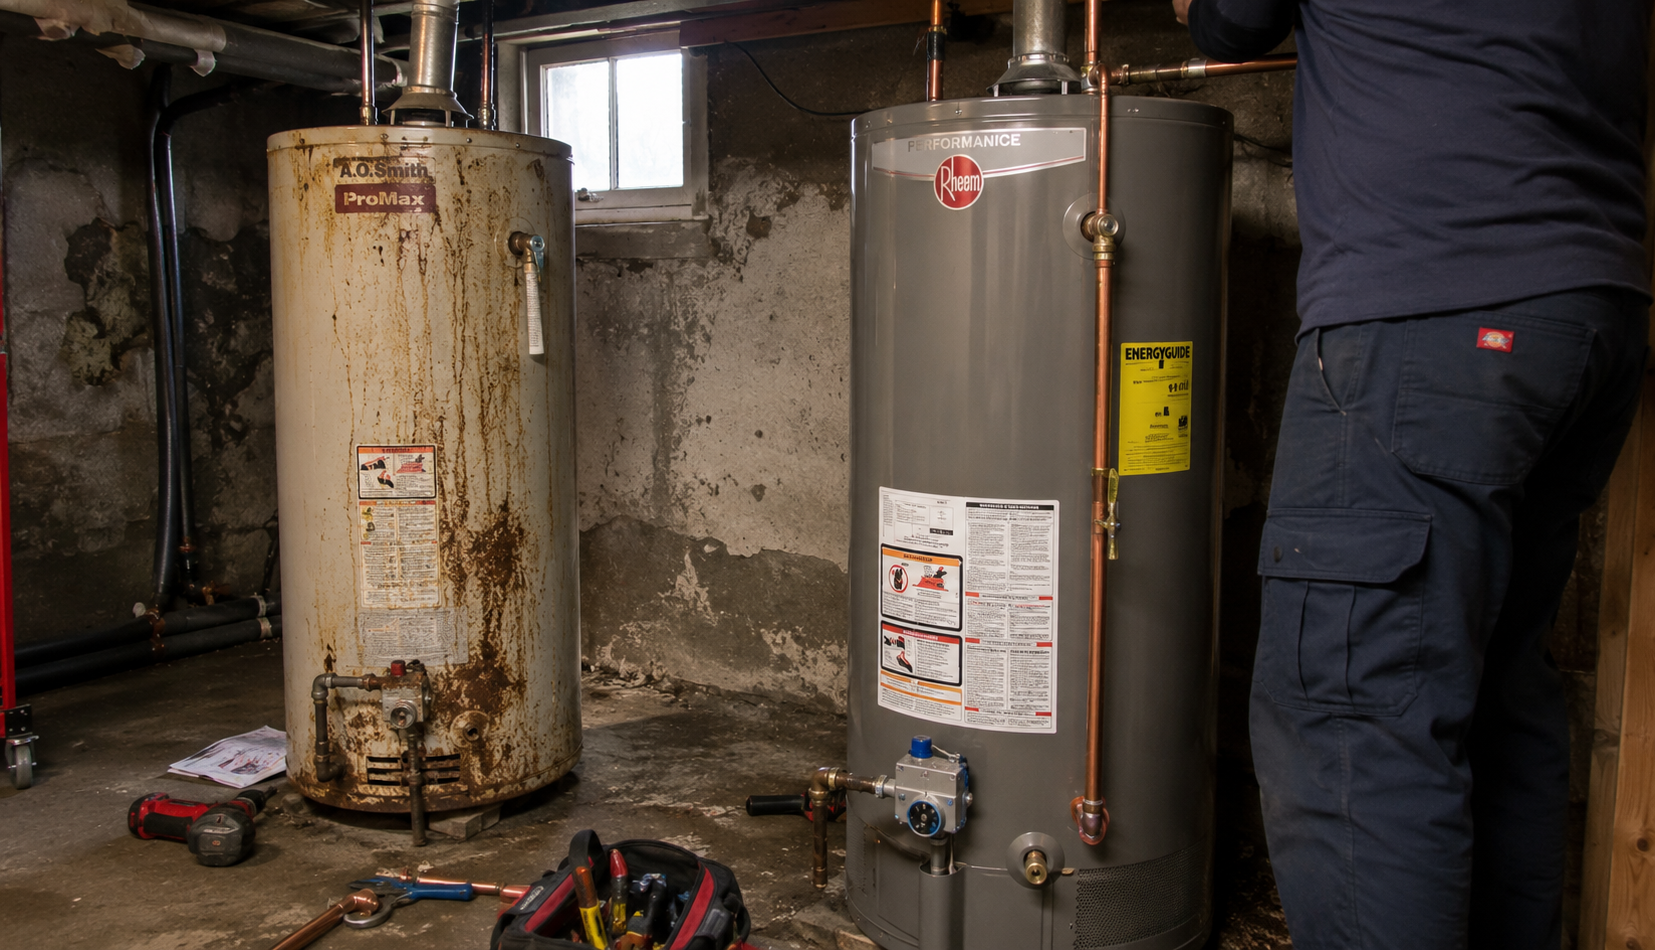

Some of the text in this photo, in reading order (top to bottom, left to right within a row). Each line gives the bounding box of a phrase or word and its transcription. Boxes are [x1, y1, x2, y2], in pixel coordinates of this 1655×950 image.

[908, 133, 1021, 152] PERFORMANICE
[940, 156, 980, 202] Rheem
[343, 191, 426, 206] ProMax
[1125, 345, 1191, 361] ENERGYGUIDE
